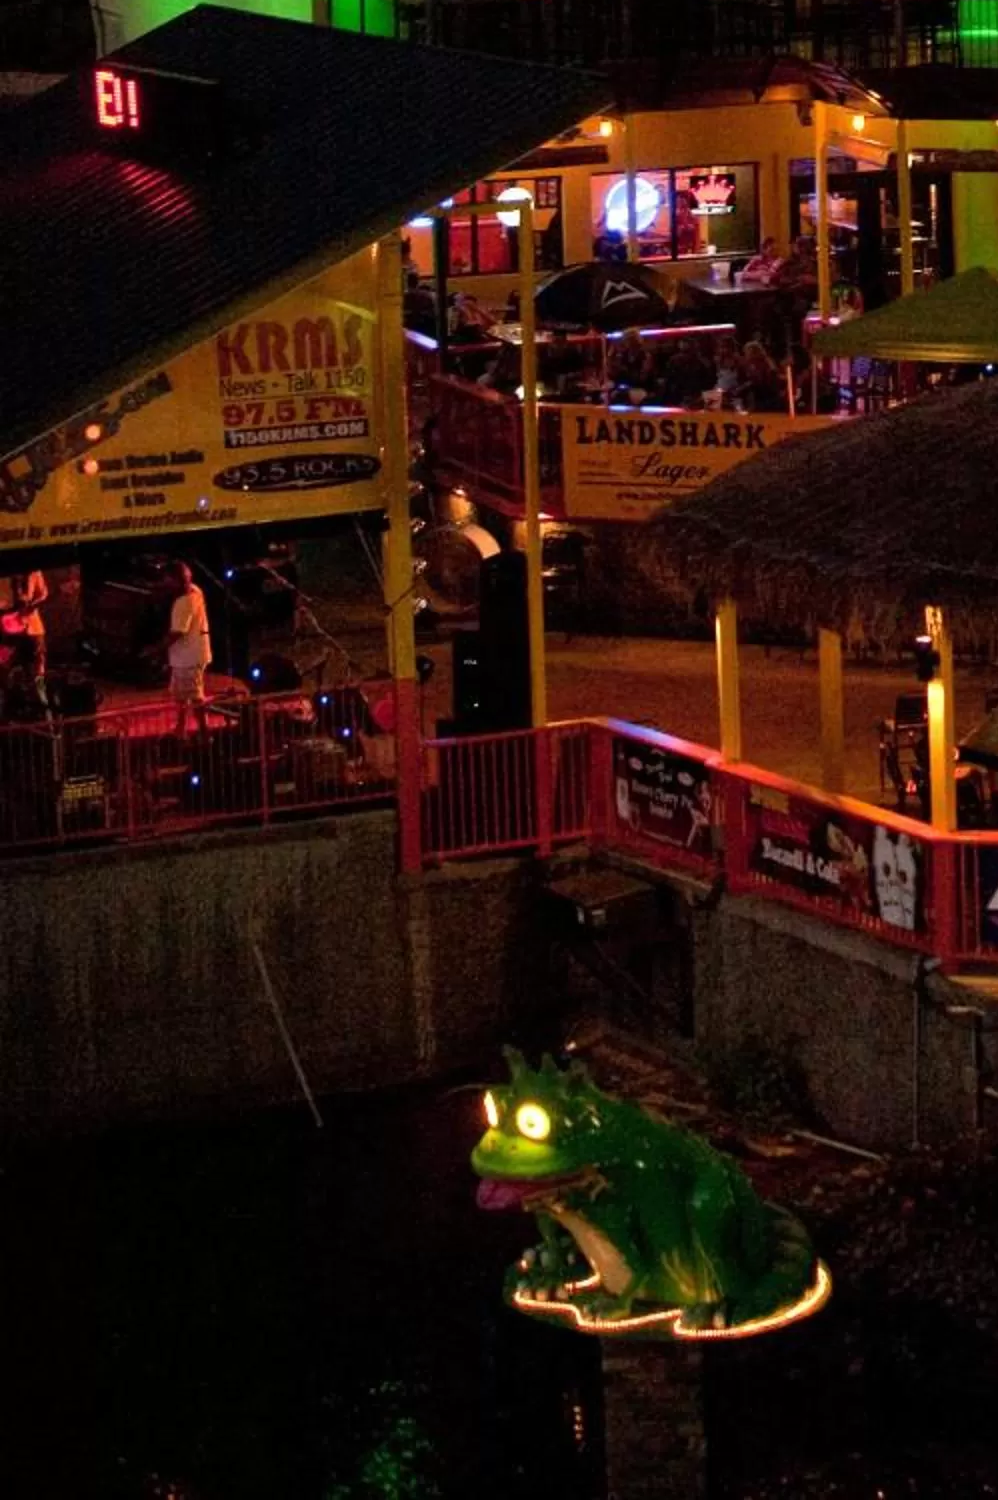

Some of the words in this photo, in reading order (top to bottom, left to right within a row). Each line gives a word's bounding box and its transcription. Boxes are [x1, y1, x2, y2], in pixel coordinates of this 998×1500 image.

[217, 315, 363, 377] KRMS
[220, 378, 266, 397] News
[286, 373, 316, 392] Talk
[325, 369, 366, 389] 1150
[223, 401, 297, 426] 97.5
[305, 396, 367, 421] FM
[576, 415, 766, 450] LANDSHARK
[631, 451, 712, 487] Lager
